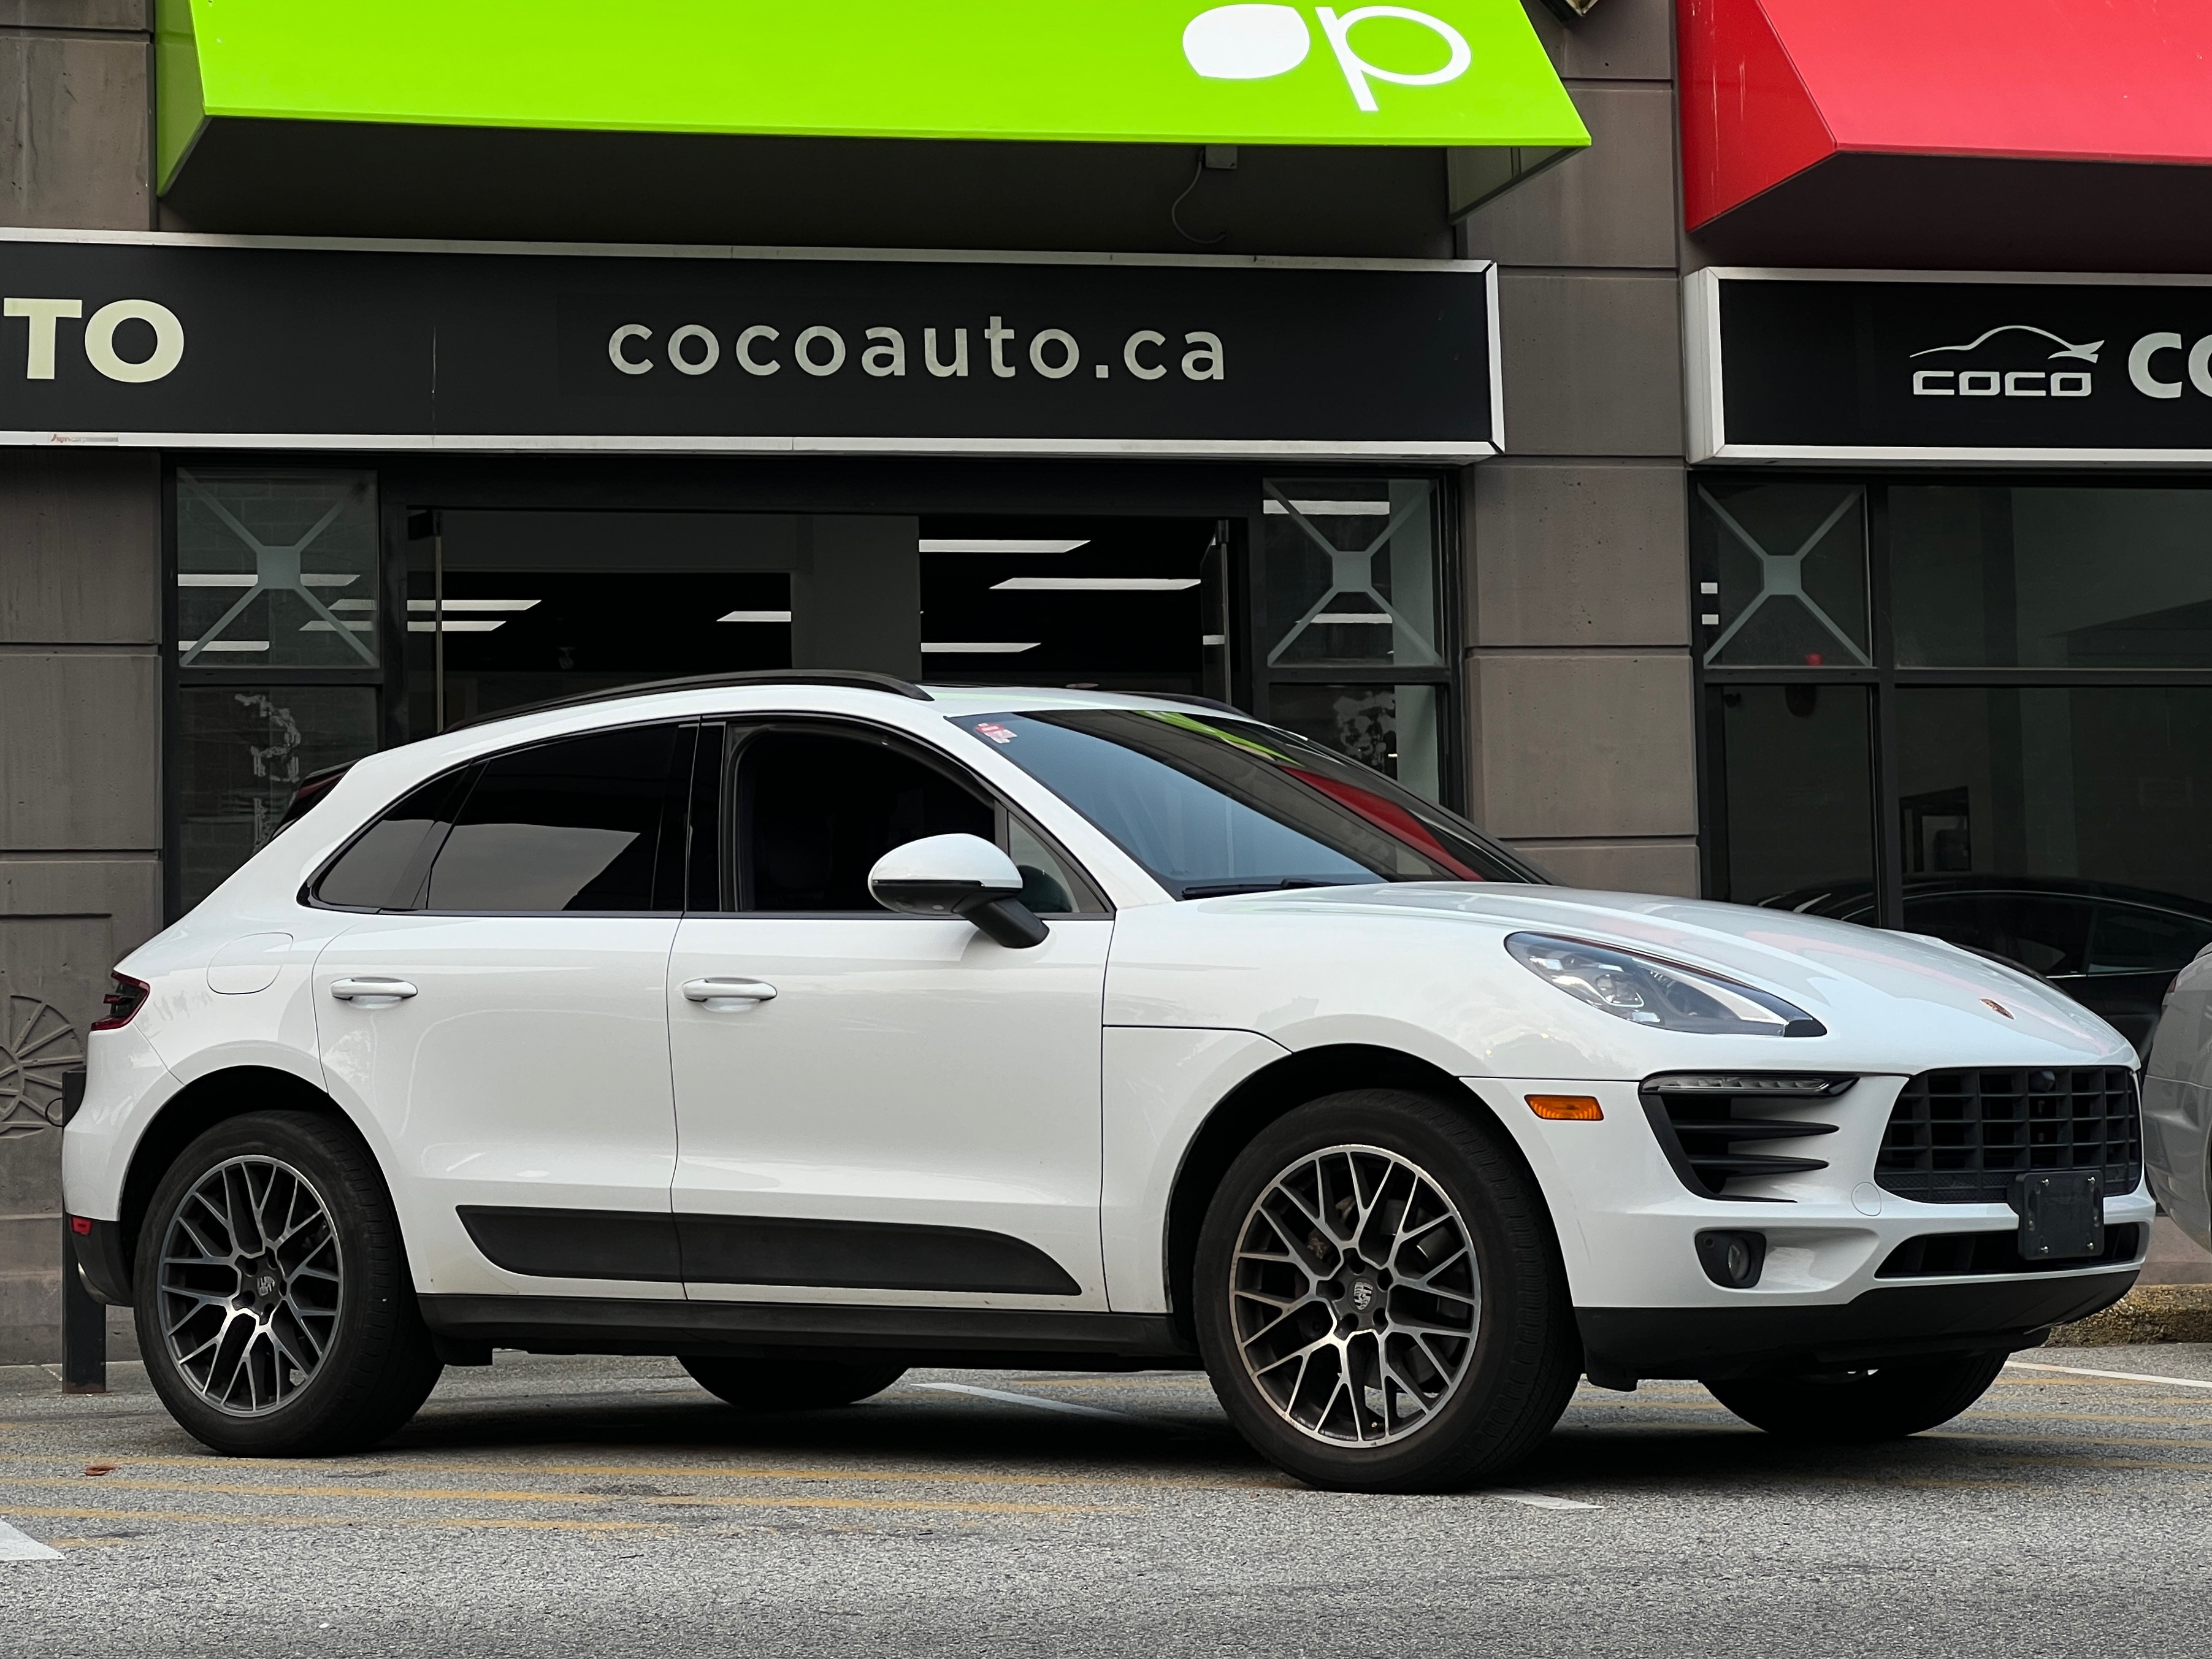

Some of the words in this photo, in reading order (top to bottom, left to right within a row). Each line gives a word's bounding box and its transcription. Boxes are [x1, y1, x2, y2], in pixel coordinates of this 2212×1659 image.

[3, 297, 185, 383] TO
[608, 316, 1225, 381] cocoauto.ca
[1913, 370, 2092, 397] COCO
